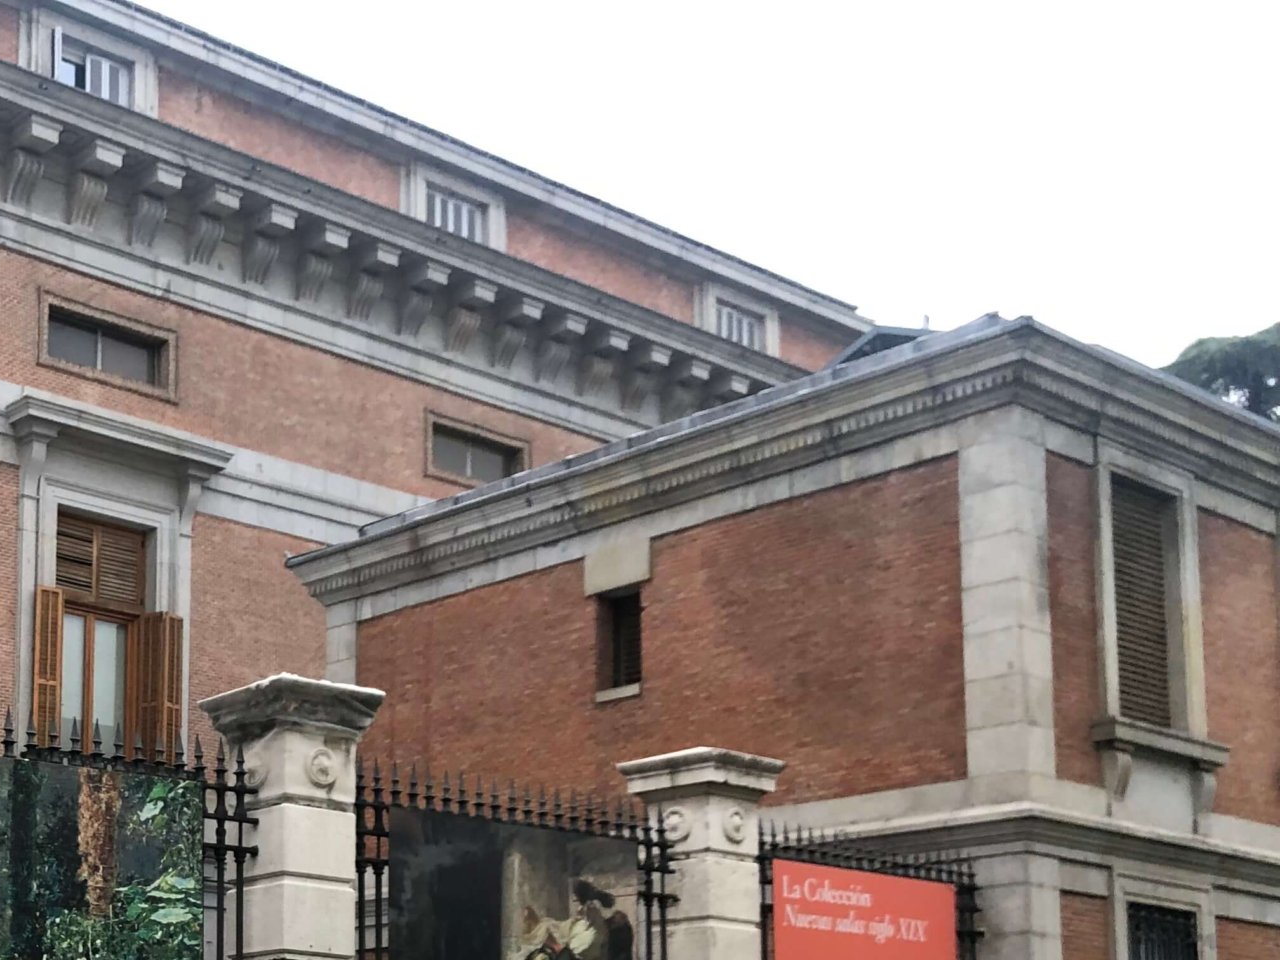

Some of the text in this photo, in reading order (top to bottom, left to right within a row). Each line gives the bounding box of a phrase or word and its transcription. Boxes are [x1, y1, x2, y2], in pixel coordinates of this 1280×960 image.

[782, 874, 872, 907] La Colección
[782, 903, 929, 944] Nuevas salas siglo XIX
